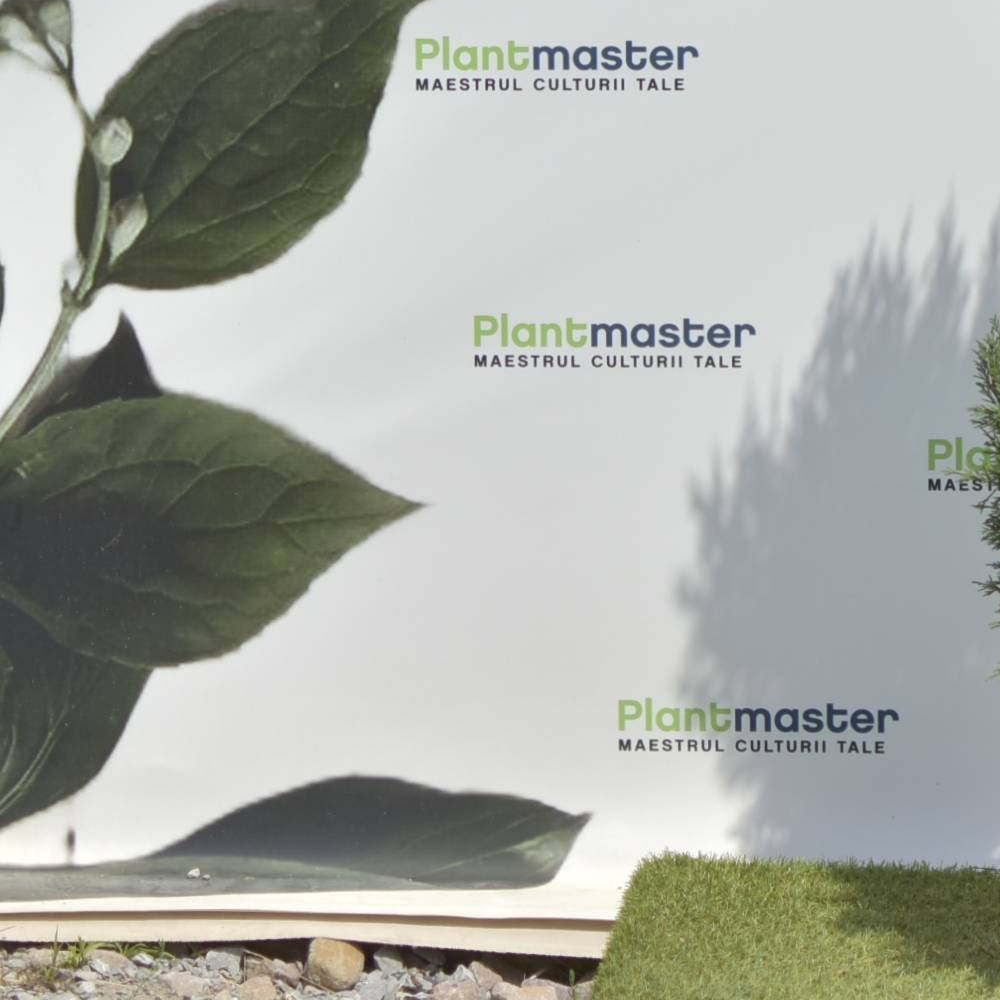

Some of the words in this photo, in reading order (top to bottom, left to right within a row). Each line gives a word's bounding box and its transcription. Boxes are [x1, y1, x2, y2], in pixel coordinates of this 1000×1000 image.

[416, 36, 699, 71] Plantmaster
[416, 78, 522, 91] MAESTRUL
[533, 78, 624, 91] CULTURII
[636, 78, 684, 91] TALE
[474, 313, 756, 348] Plantmaster
[474, 355, 580, 368] MAESTRUL
[591, 355, 682, 368] CULTURII
[694, 355, 741, 368] TALE
[618, 698, 899, 734] Plantmaster
[618, 739, 724, 752] MAESTRUL
[736, 740, 826, 753] CULTURII
[837, 741, 884, 754] TALE
